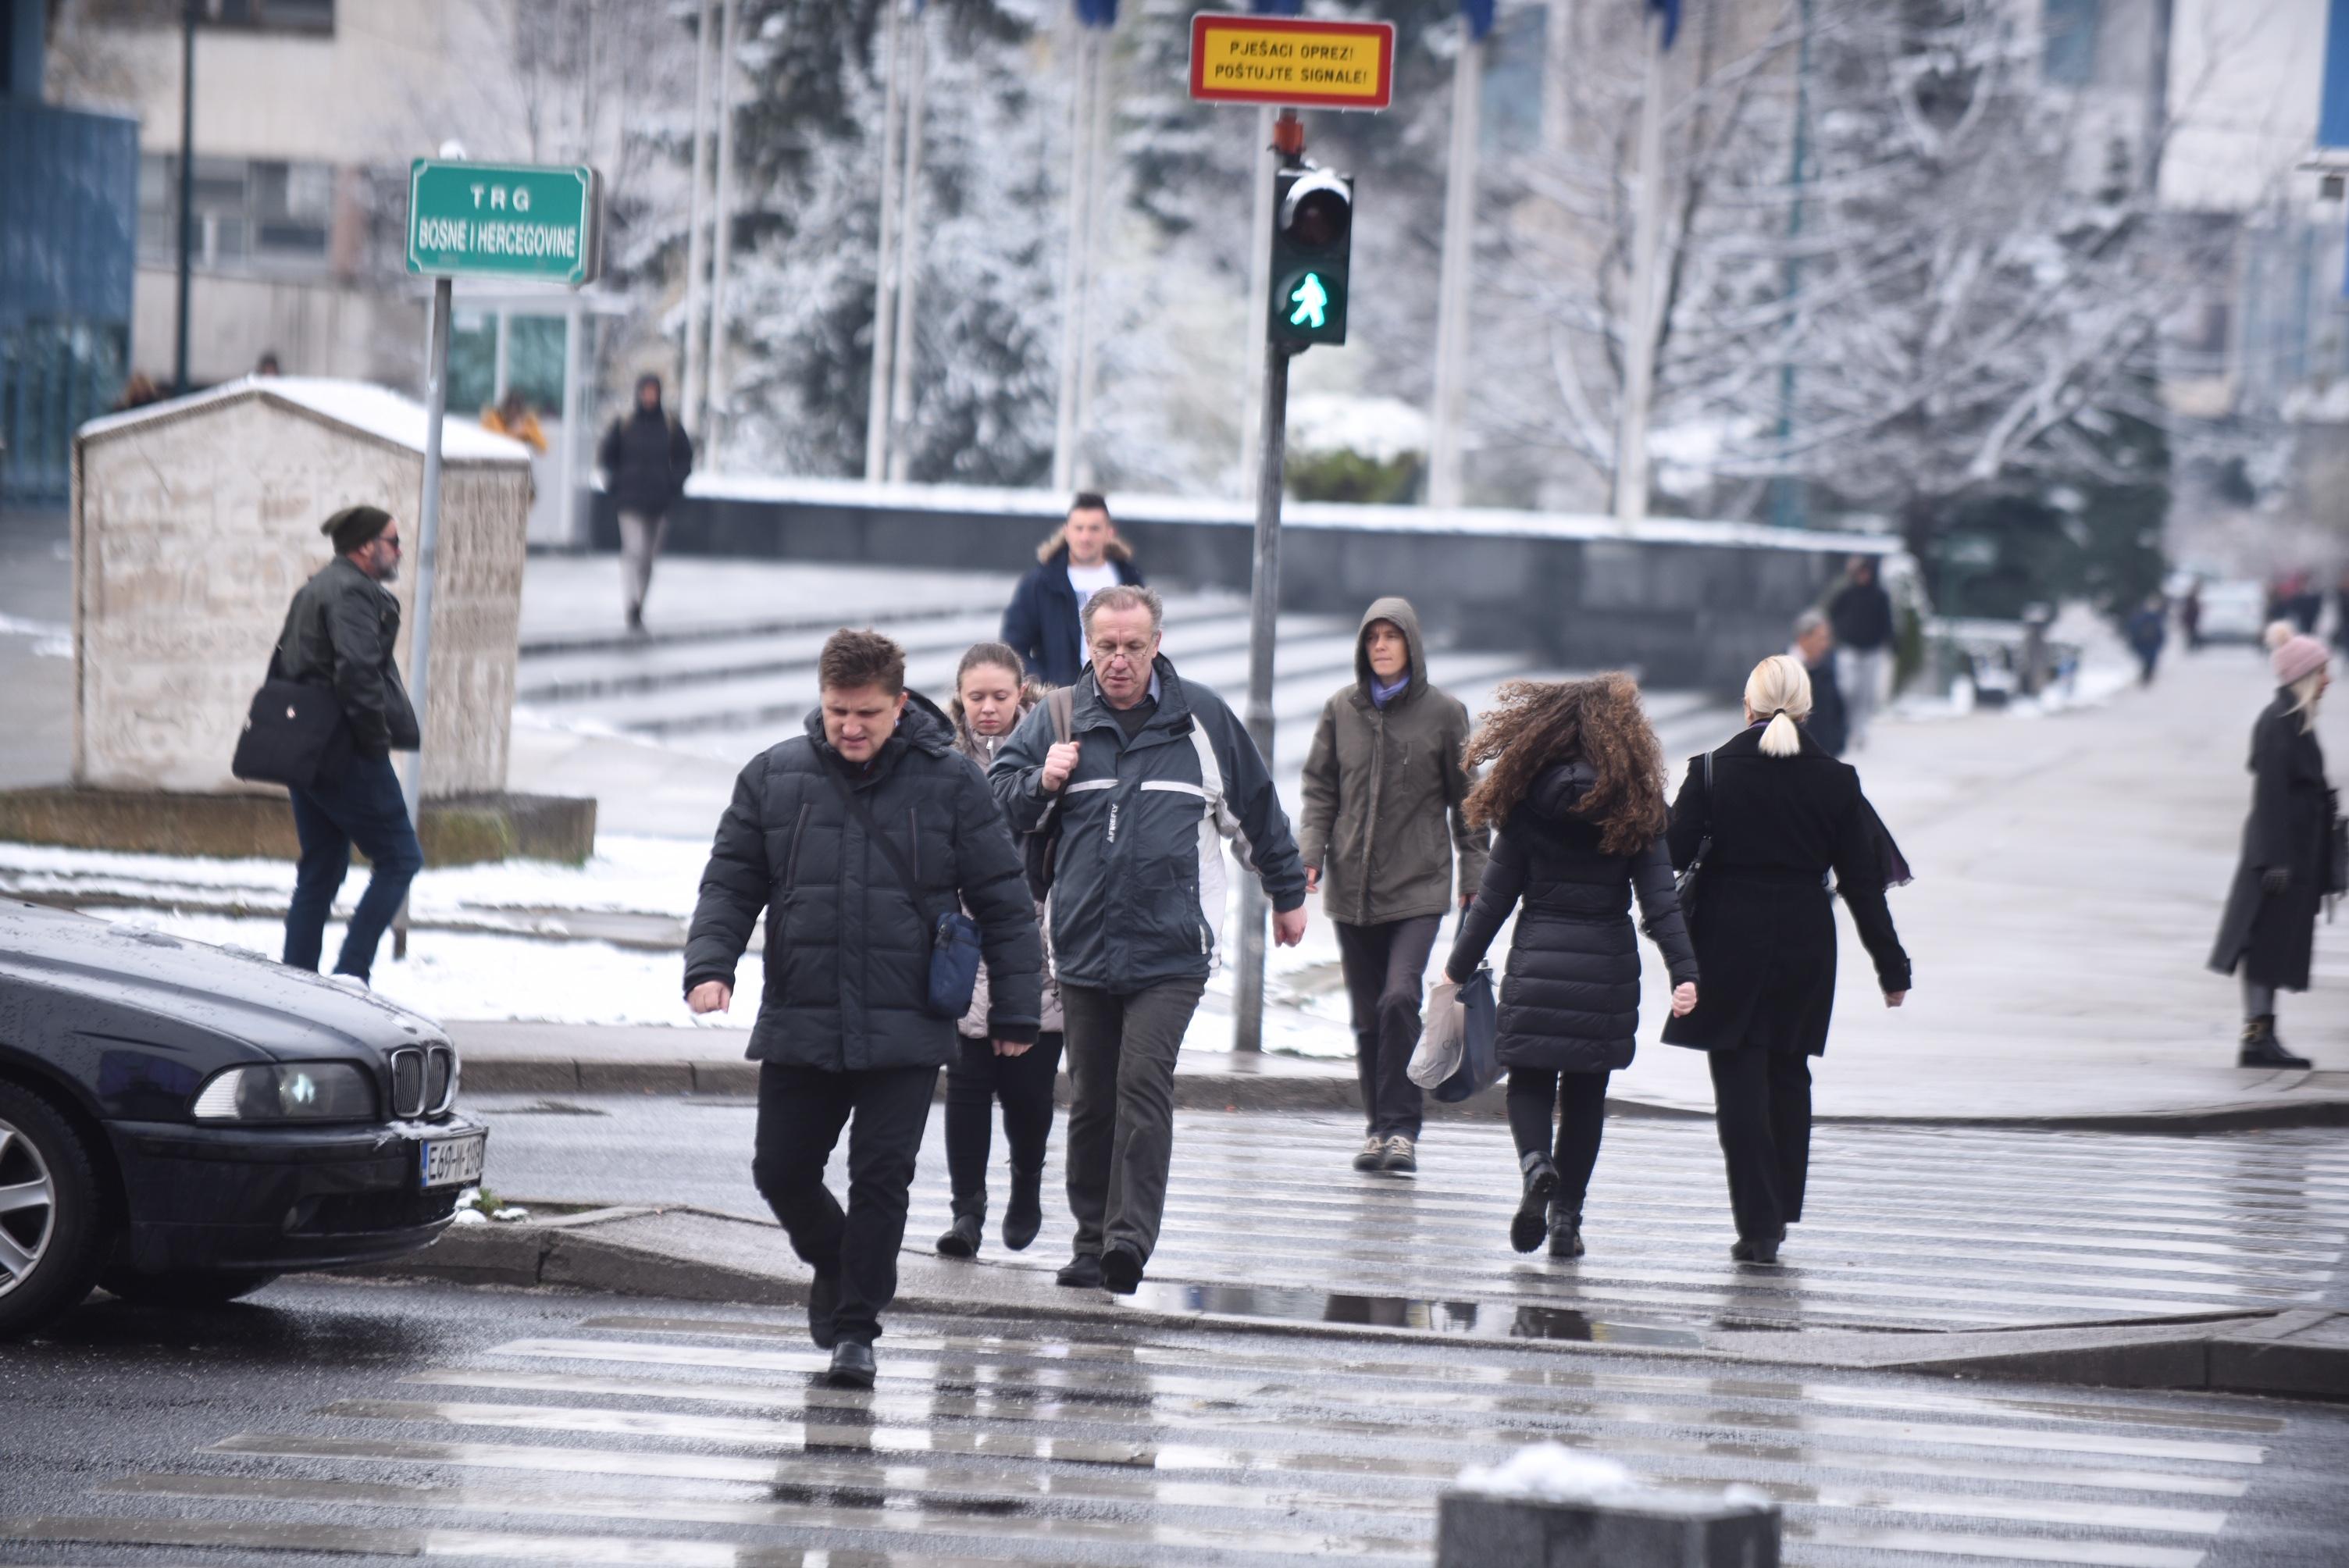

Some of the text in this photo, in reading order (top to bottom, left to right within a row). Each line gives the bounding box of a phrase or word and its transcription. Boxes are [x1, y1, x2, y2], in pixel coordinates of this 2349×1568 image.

[1229, 40, 1354, 62] PJEŠACI OPREZ!
[1214, 62, 1367, 85] POŠTUJTE SIGNALE!
[470, 184, 530, 212] TRG
[419, 218, 576, 258] BOSNE I HERCEGOVINE
